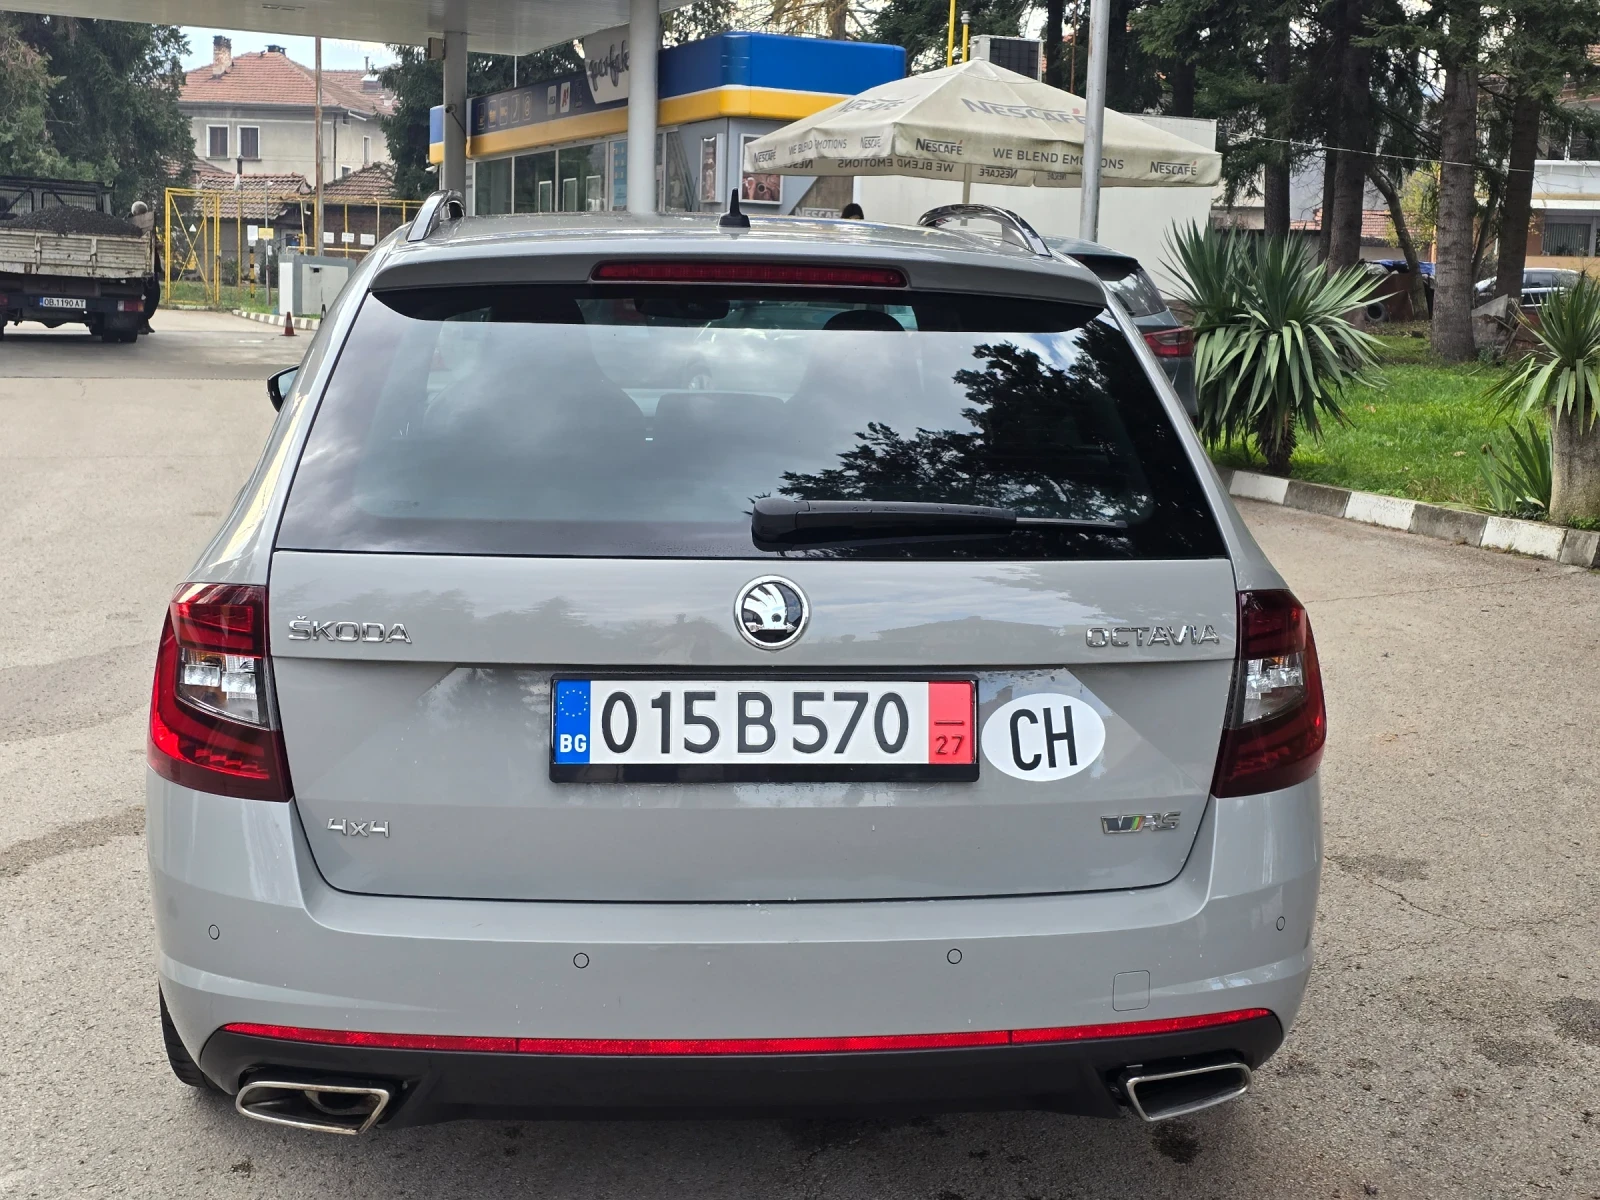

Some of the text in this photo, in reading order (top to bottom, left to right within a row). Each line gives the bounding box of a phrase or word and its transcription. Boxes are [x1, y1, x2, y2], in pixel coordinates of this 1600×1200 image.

[993, 147, 1125, 170] WE BLEND EMONS
[794, 206, 842, 219] NESCAF
[288, 615, 412, 644] ŠKODA
[1085, 624, 1221, 647] OCTAVIA
[559, 733, 587, 753] BG
[935, 734, 965, 756] 27
[1009, 705, 1078, 772] CH
